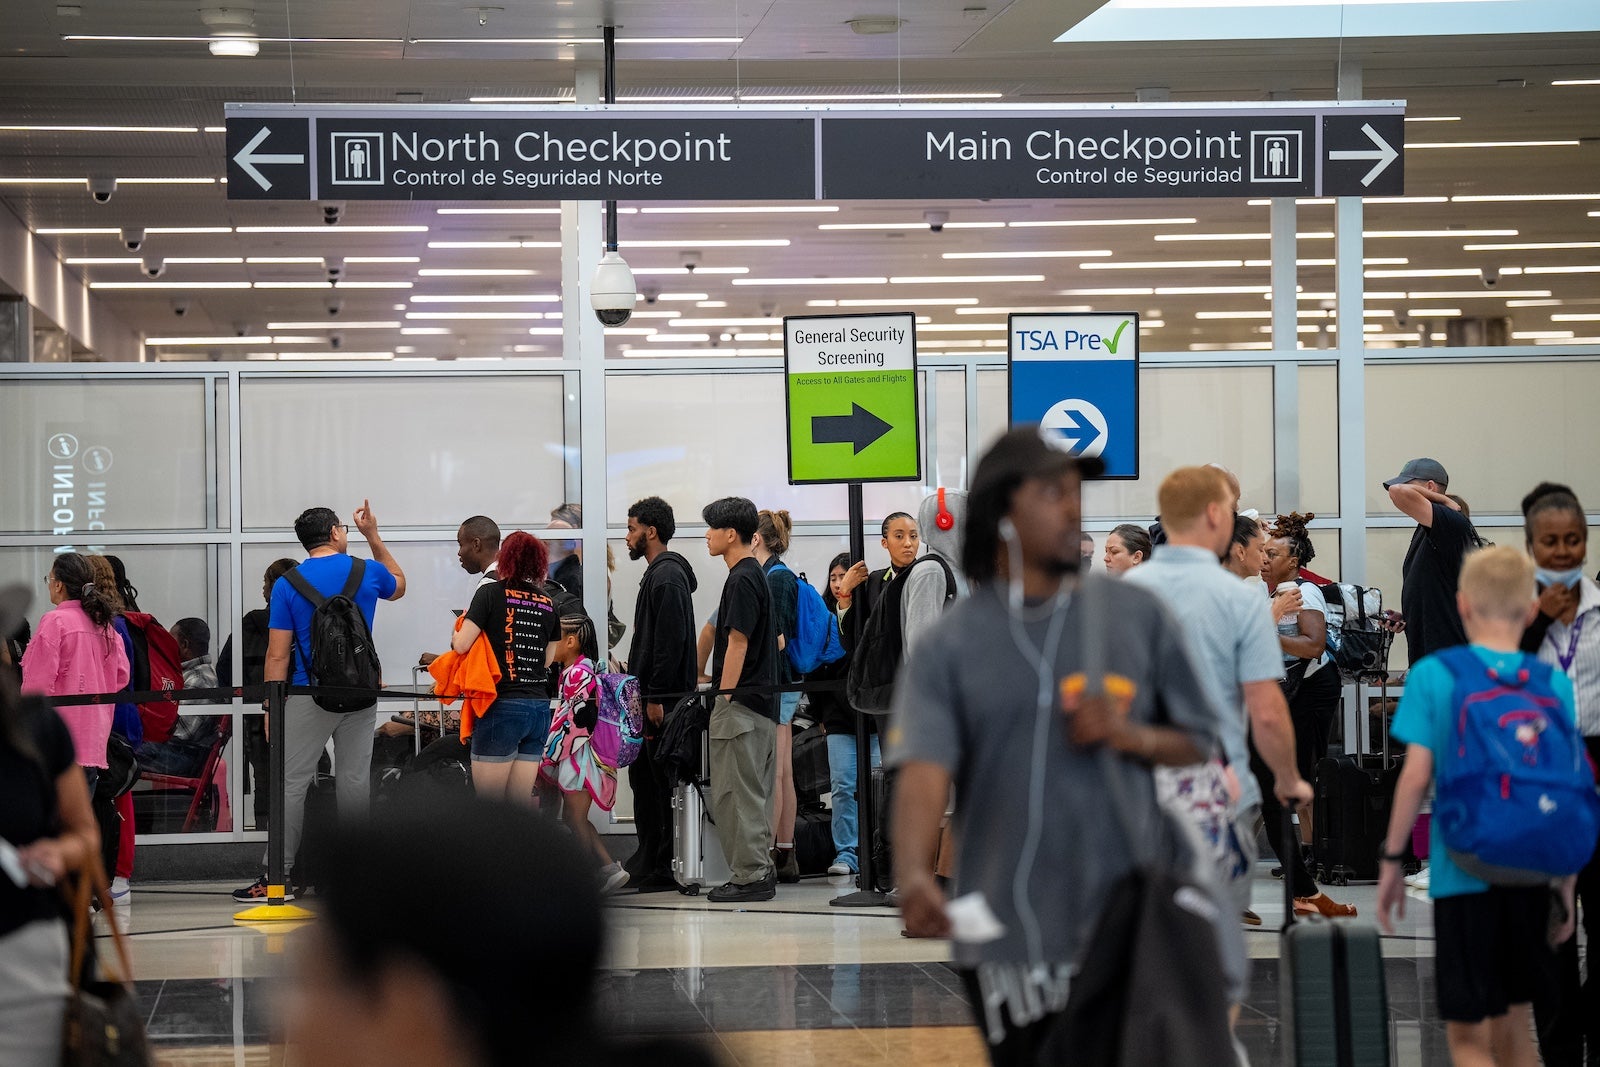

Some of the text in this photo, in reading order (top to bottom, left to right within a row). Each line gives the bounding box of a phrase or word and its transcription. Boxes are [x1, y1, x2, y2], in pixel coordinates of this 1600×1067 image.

[392, 130, 732, 166] North Checkpoint
[926, 129, 1242, 165] Main Checkpoint
[392, 169, 663, 189] Control de Seguridad Norte
[1036, 166, 1242, 186] Control de Seguridad
[795, 326, 905, 345] General Security
[1016, 329, 1101, 351] TSA Pre
[818, 349, 884, 367] Screening
[796, 374, 907, 386] Access to All Gates and Flights
[505, 589, 554, 607] NCT 127
[505, 607, 515, 643] LINK
